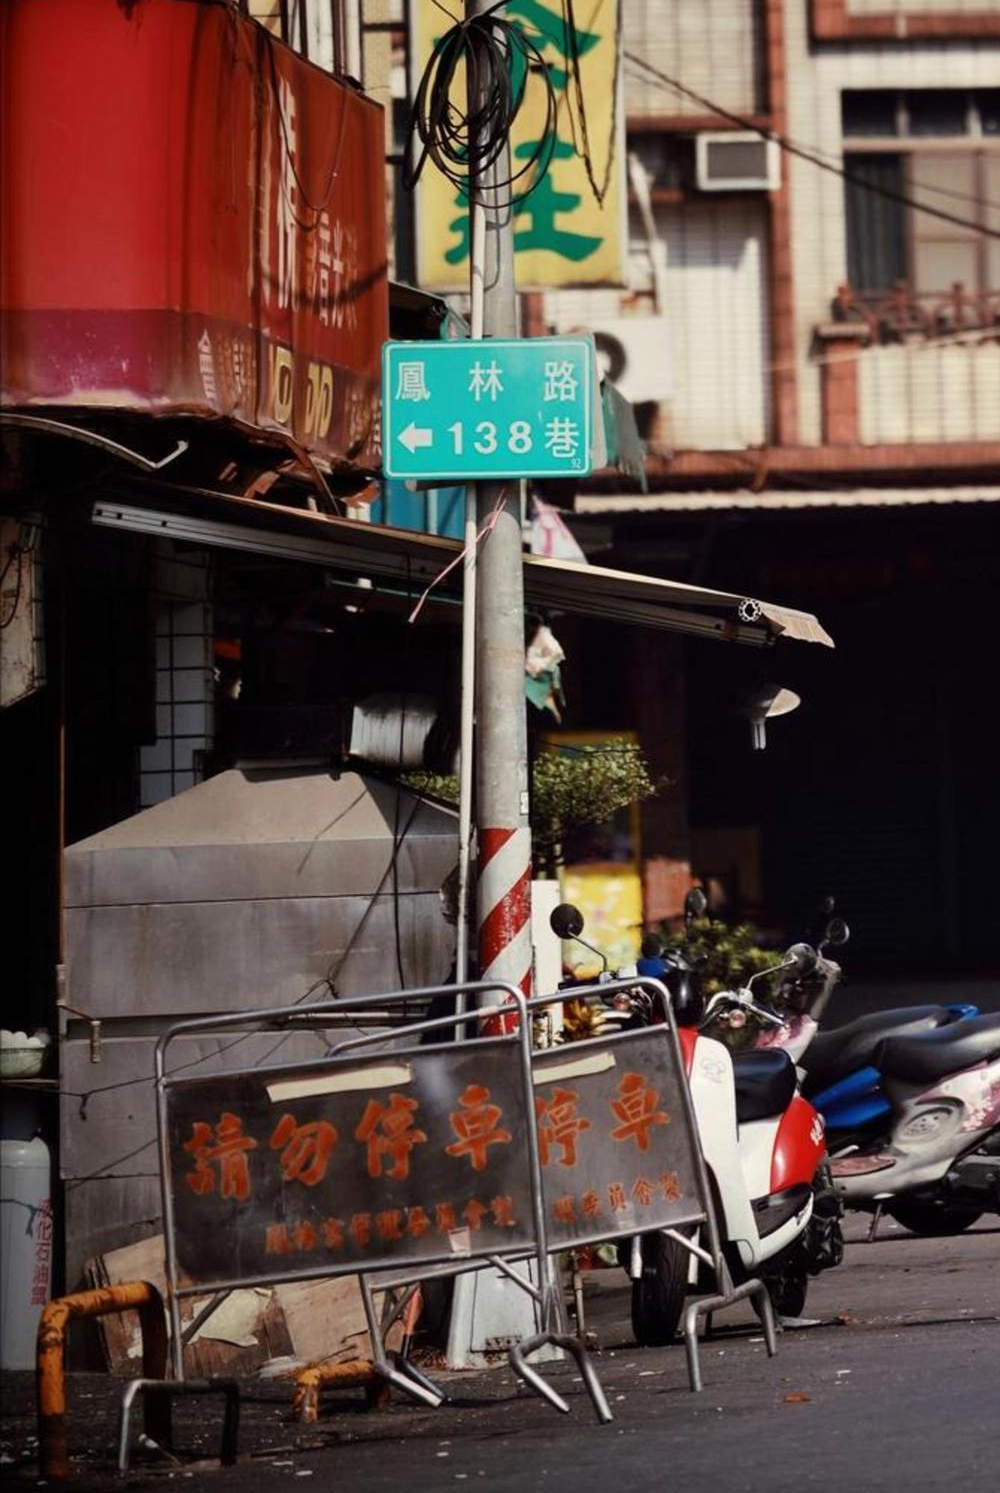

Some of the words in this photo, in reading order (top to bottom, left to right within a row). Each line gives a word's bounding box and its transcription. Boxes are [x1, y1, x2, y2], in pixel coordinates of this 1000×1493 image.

[395, 360, 579, 401] 鳳林路
[184, 1085, 511, 1200] 請勿停車
